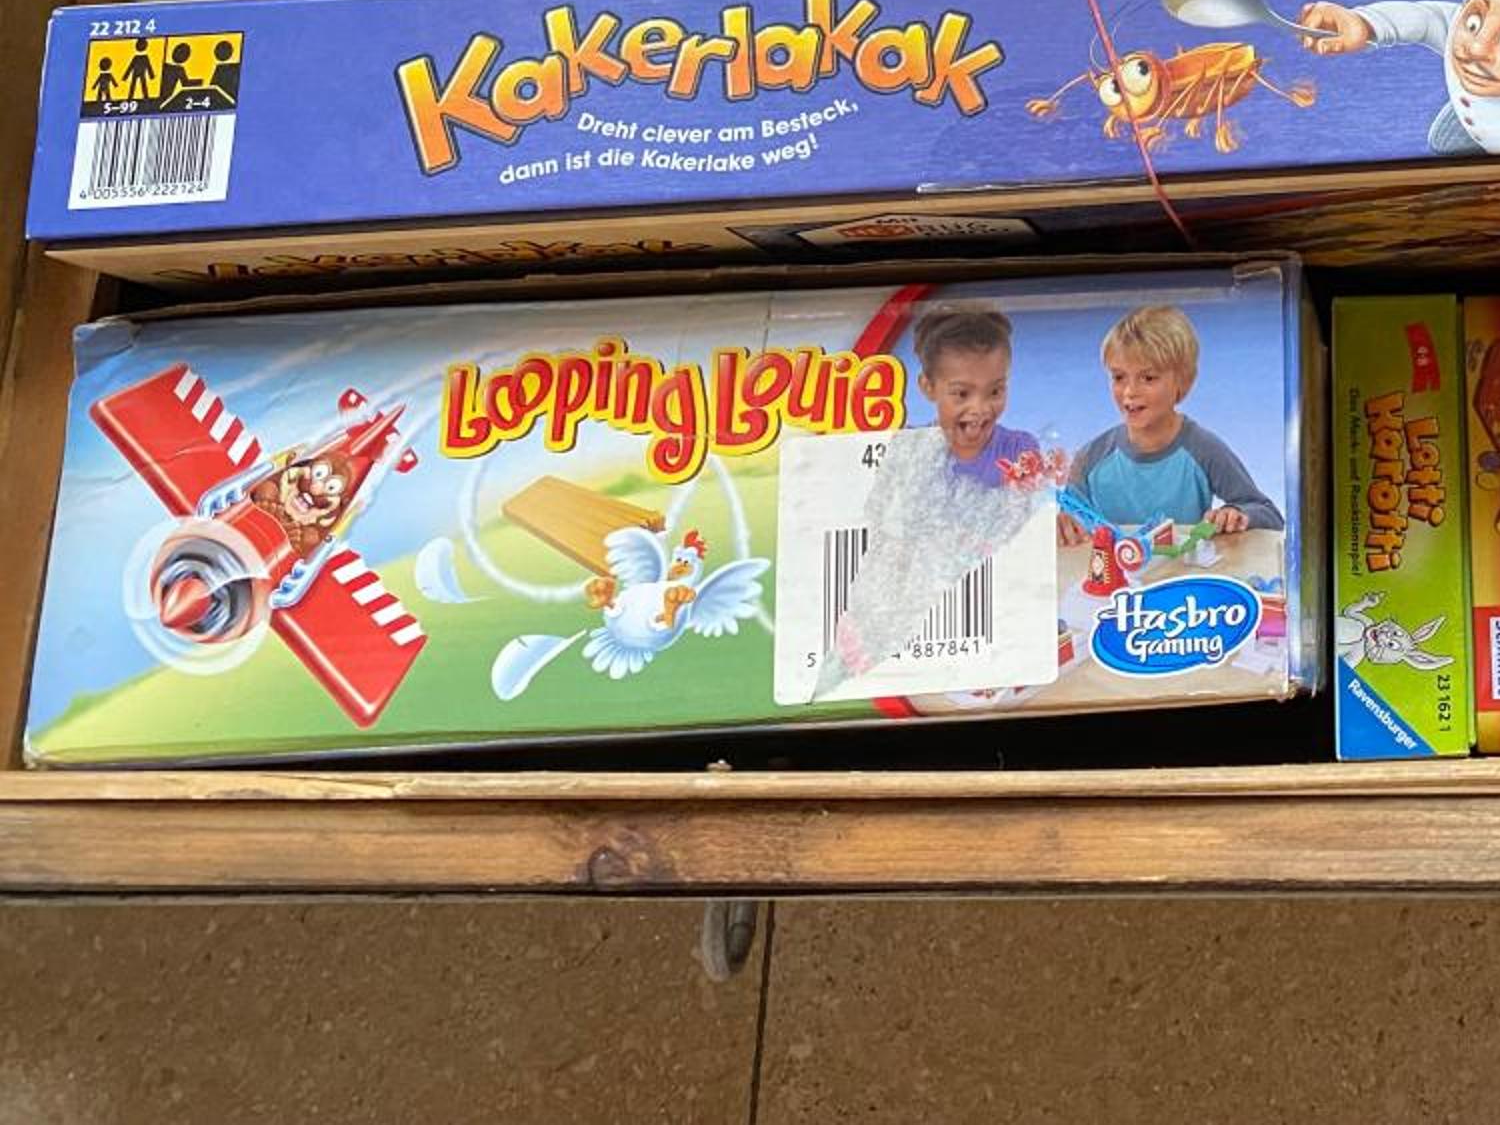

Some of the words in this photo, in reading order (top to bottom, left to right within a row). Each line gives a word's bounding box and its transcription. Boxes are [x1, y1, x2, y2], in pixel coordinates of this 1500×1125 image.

[89, 21, 111, 36] 22
[113, 20, 142, 35] 212
[145, 18, 157, 33] 4
[576, 112, 639, 140] Dreht
[642, 123, 711, 144] clever
[718, 125, 754, 142] am
[760, 97, 859, 139] Besteck,
[499, 157, 559, 185] dann
[565, 149, 592, 171] ist
[597, 146, 635, 167] die
[641, 149, 755, 173] Kakerlake
[761, 132, 819, 167] weg!
[444, 339, 707, 480] Looping
[711, 349, 904, 452] Louie
[1363, 389, 1407, 575] Karotti
[1405, 415, 1448, 529] Lotti
[1097, 593, 1247, 638] Hasbro
[1124, 630, 1223, 665] Gaming
[1437, 674, 1451, 692] 23
[1347, 678, 1419, 750] Ravensburger
[1437, 695, 1452, 723] 162
